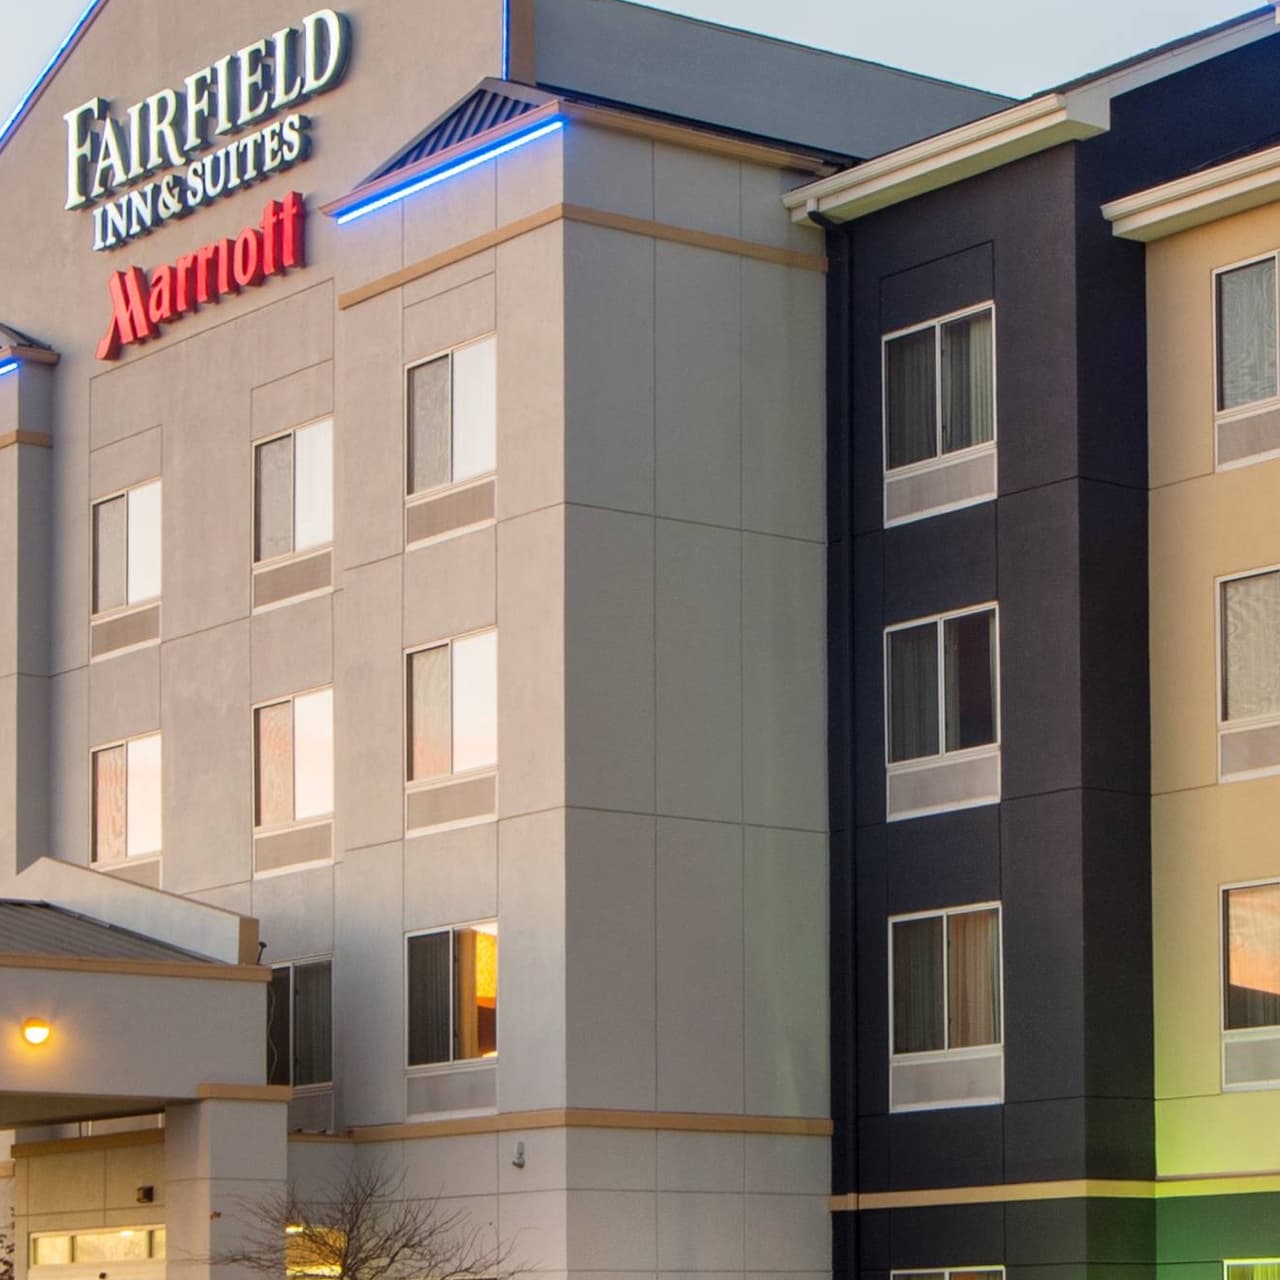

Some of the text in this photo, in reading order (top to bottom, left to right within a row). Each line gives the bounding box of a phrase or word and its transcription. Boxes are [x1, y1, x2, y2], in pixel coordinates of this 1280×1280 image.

[64, 8, 345, 210] FAIRFIELD
[92, 183, 153, 251] INN
[186, 113, 308, 208] SUITES
[95, 191, 305, 360] Marriott
